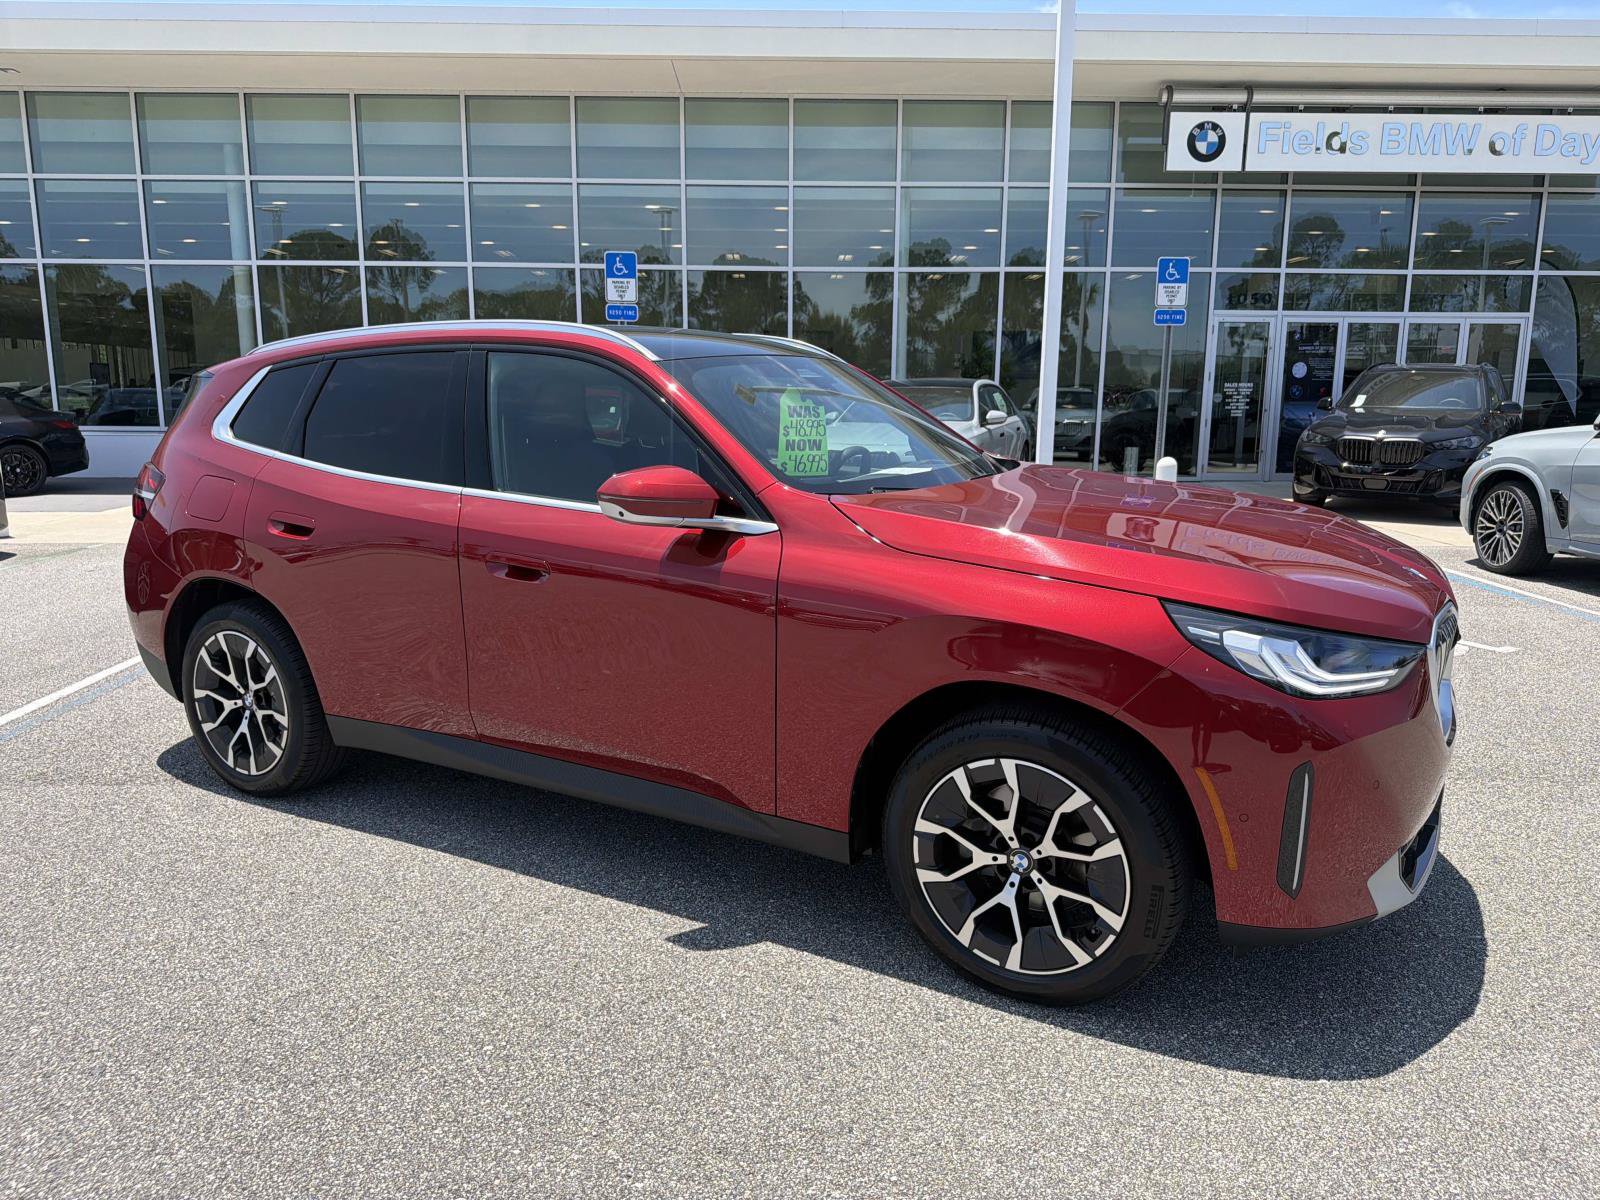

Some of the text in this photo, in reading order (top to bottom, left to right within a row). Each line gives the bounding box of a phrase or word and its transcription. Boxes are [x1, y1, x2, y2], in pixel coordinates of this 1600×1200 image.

[1192, 122, 1224, 136] BMW
[1257, 121, 1370, 155] Fields
[1380, 122, 1482, 156] BMW
[1488, 123, 1529, 156] of
[788, 405, 821, 418] WAS
[785, 439, 822, 451] NOW
